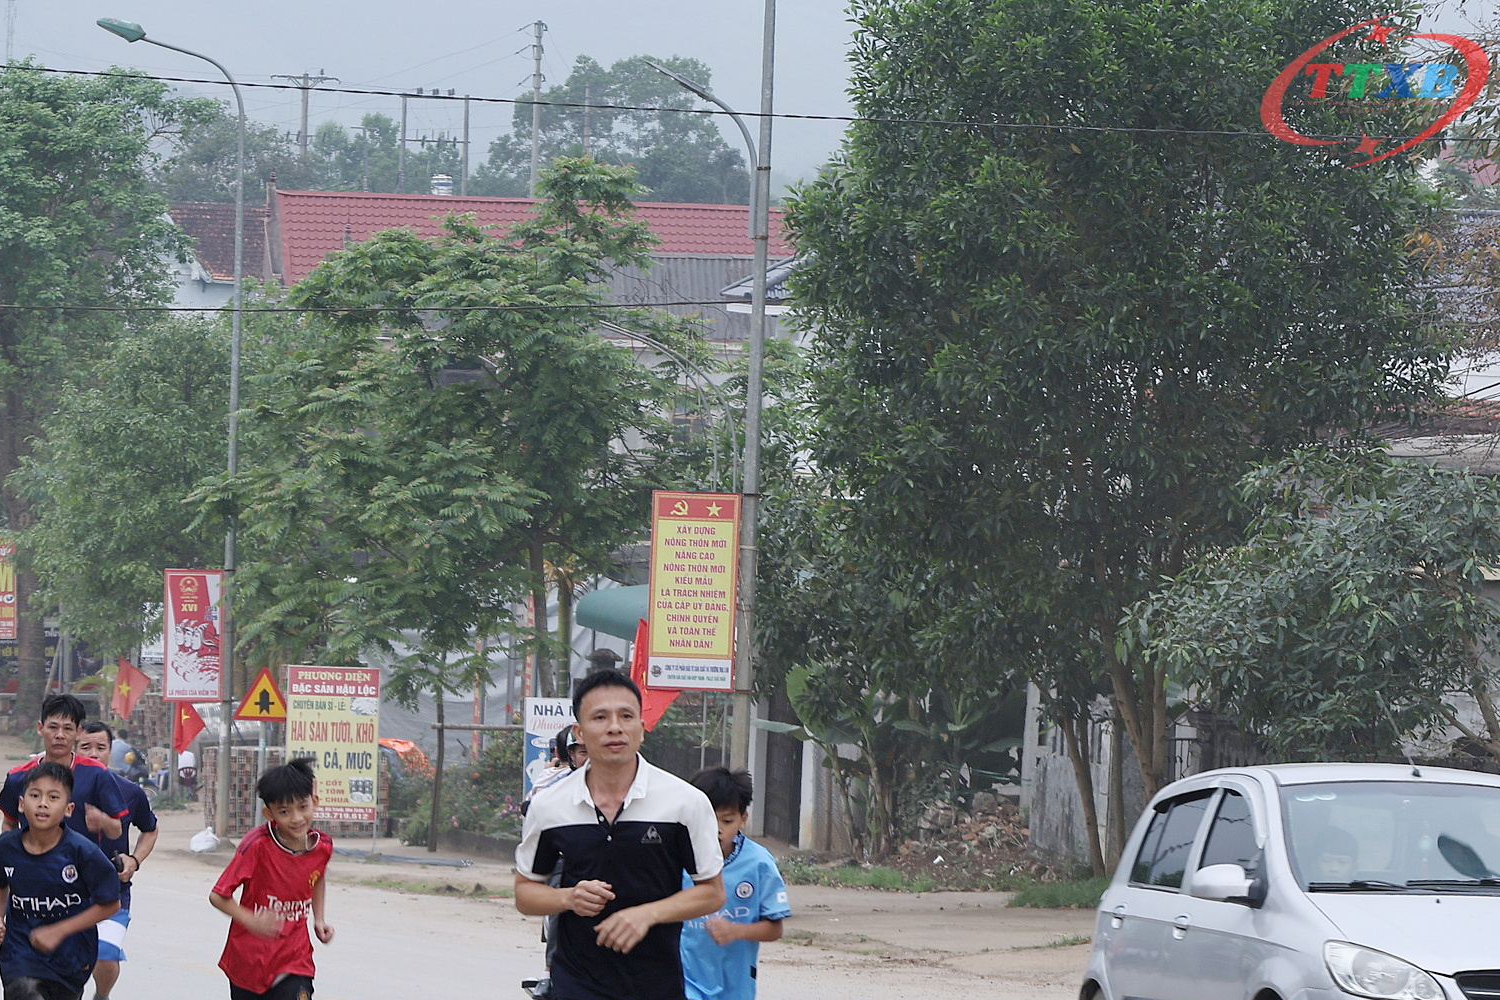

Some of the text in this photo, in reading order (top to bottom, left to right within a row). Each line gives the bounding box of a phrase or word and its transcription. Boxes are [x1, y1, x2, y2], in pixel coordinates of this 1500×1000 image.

[676, 525, 716, 537] XÂY DỰNG
[664, 537, 727, 548] NÔNG THÔN MỚI
[699, 552, 715, 561] CAO
[663, 562, 726, 573] NÔNG THÔN MỚI
[661, 587, 726, 600] LÀ TRÁCH NHIỆM
[181, 603, 198, 612] XVI
[657, 598, 673, 609] CỦA
[666, 613, 719, 624] CHÍNH QUYỀN
[667, 625, 677, 635] VÀ
[680, 625, 700, 636] TOÀN
[669, 638, 713, 649] NHÂN DÂN!
[298, 670, 371, 684] PHƯƠNG DIỆN
[292, 681, 377, 697] ĐẶC SẢN HẬU LỘC
[293, 699, 314, 710] CHUYÊN
[314, 699, 327, 711] BÁN
[534, 701, 564, 717] NHÀ
[291, 712, 375, 745] HẢI SẢN TƯƠI, KHÔ
[323, 748, 372, 774] CÁ, MỰC
[12, 893, 82, 911] ETIHAD
[267, 894, 303, 912] Team
